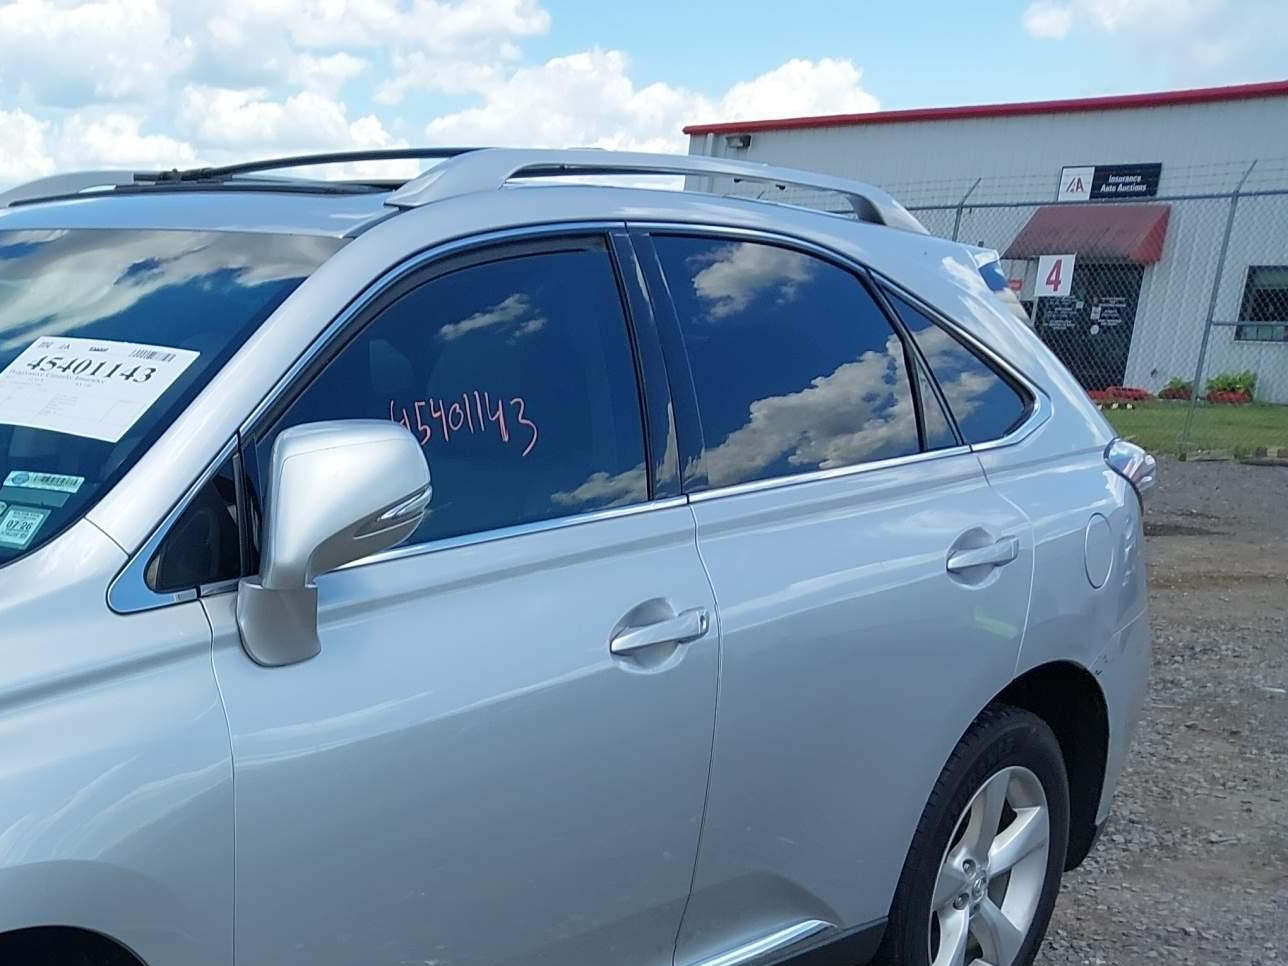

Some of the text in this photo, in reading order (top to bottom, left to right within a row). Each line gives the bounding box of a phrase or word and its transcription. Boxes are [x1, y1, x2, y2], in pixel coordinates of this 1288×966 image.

[1100, 182, 1148, 193] Auto Auctions
[1108, 174, 1142, 183] Insurance
[1045, 258, 1063, 292] 4
[26, 355, 158, 383] 45401143
